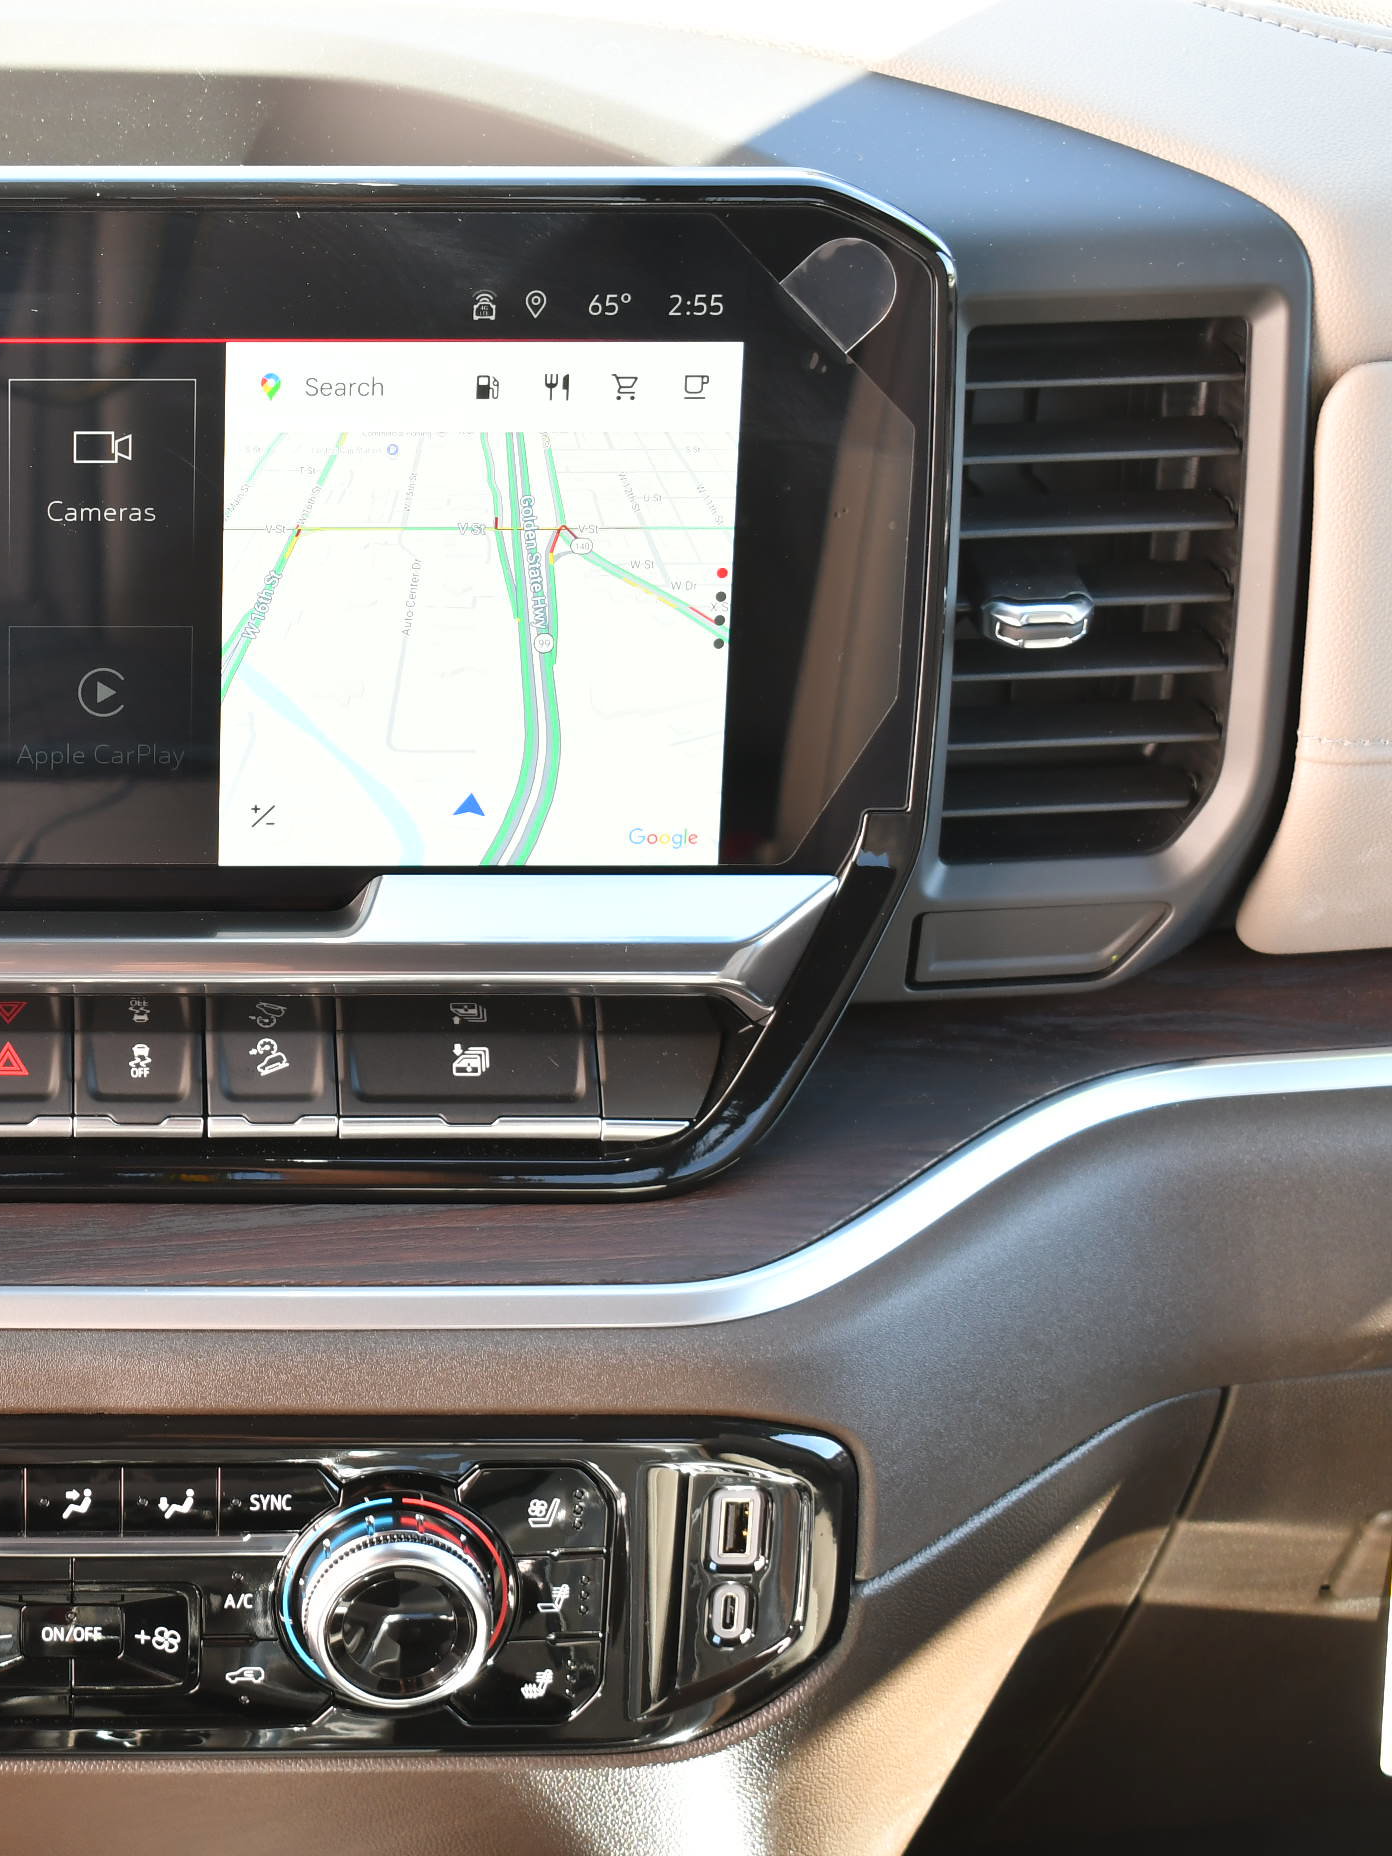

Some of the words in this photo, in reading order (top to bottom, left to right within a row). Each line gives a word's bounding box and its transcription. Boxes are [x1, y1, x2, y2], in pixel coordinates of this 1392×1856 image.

[588, 292, 632, 316] 65°
[668, 294, 724, 316] 2:55
[304, 376, 385, 398] Search
[47, 501, 156, 522] Cameras
[520, 495, 538, 549] Golden
[457, 522, 470, 536] V
[471, 522, 487, 536] St
[527, 553, 544, 593] State
[630, 560, 641, 569] W
[644, 560, 655, 569] St
[241, 622, 261, 640] W
[251, 589, 274, 621] 16th
[264, 569, 283, 588] St
[531, 596, 547, 630] Hwy
[16, 744, 86, 770] Apple
[94, 744, 185, 770] CarPlay
[628, 827, 699, 850] Google
[130, 1067, 150, 1079] OFF
[249, 1494, 293, 1511] SYNC
[224, 1593, 253, 1610] A/C
[41, 1626, 103, 1643] ON/OFF
